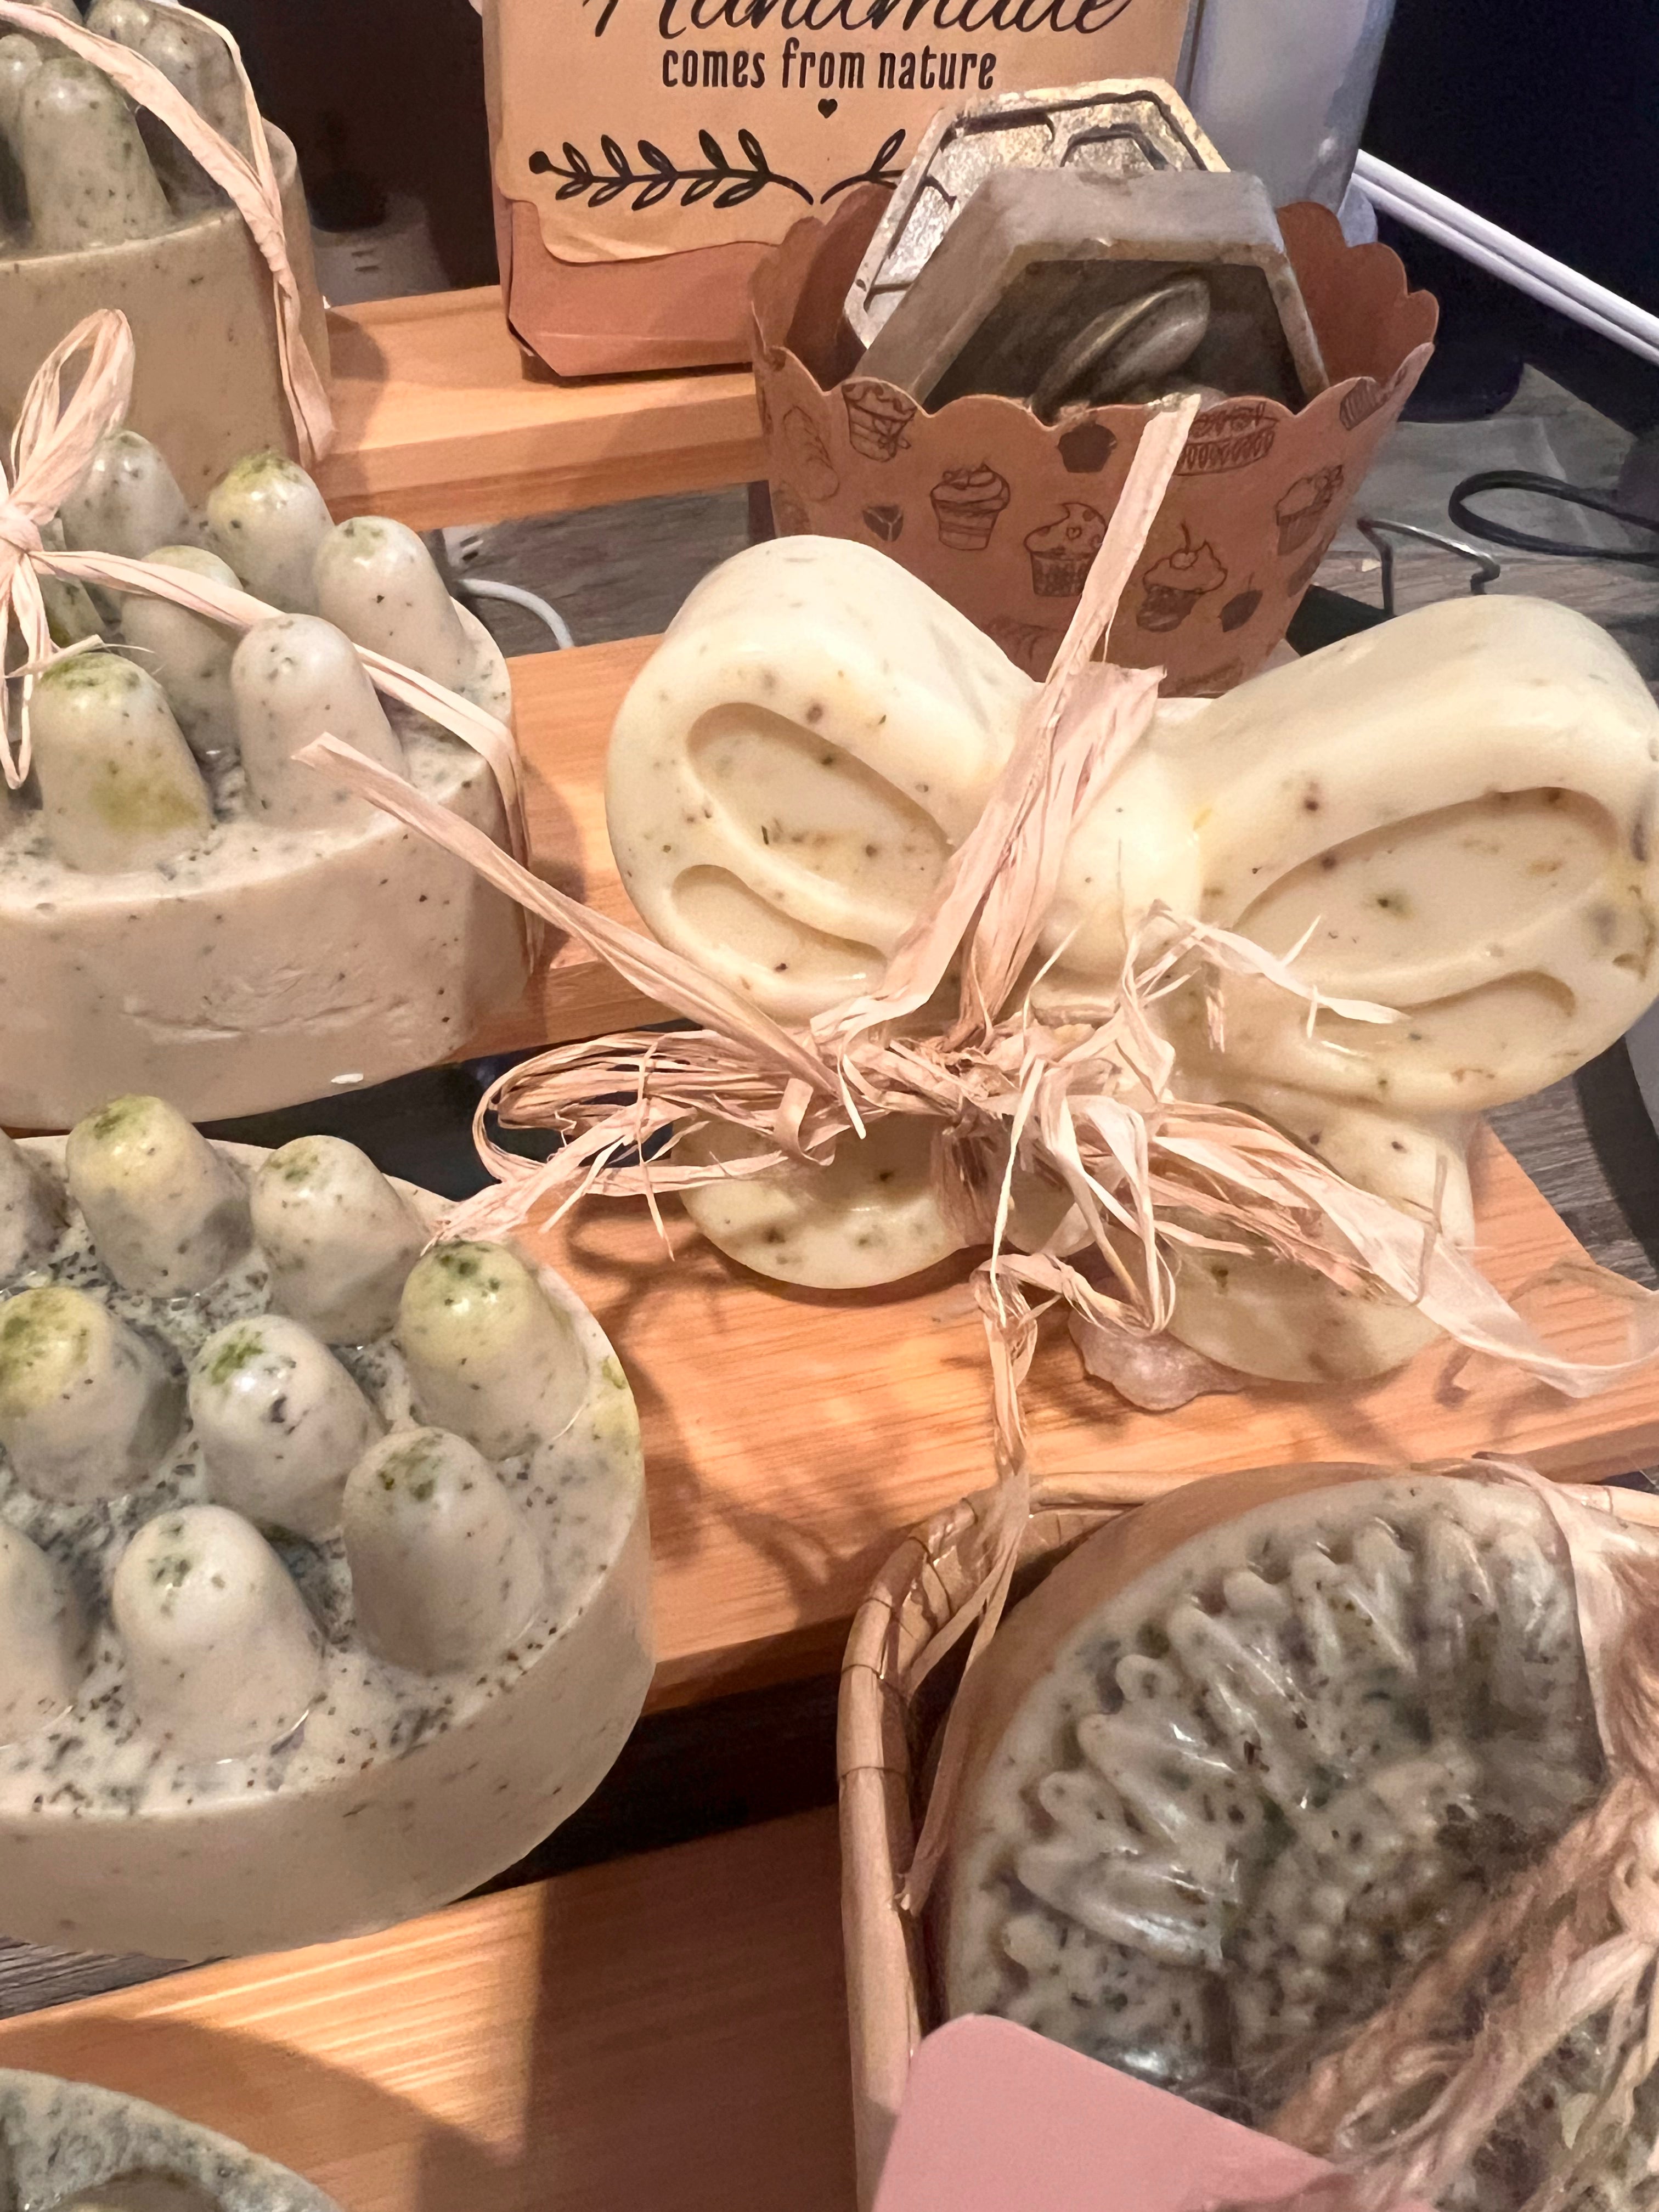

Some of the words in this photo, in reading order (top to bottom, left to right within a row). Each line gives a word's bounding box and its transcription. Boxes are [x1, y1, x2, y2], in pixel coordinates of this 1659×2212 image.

[662, 49, 766, 89] comes
[781, 36, 865, 89] from
[877, 45, 997, 90] nature
